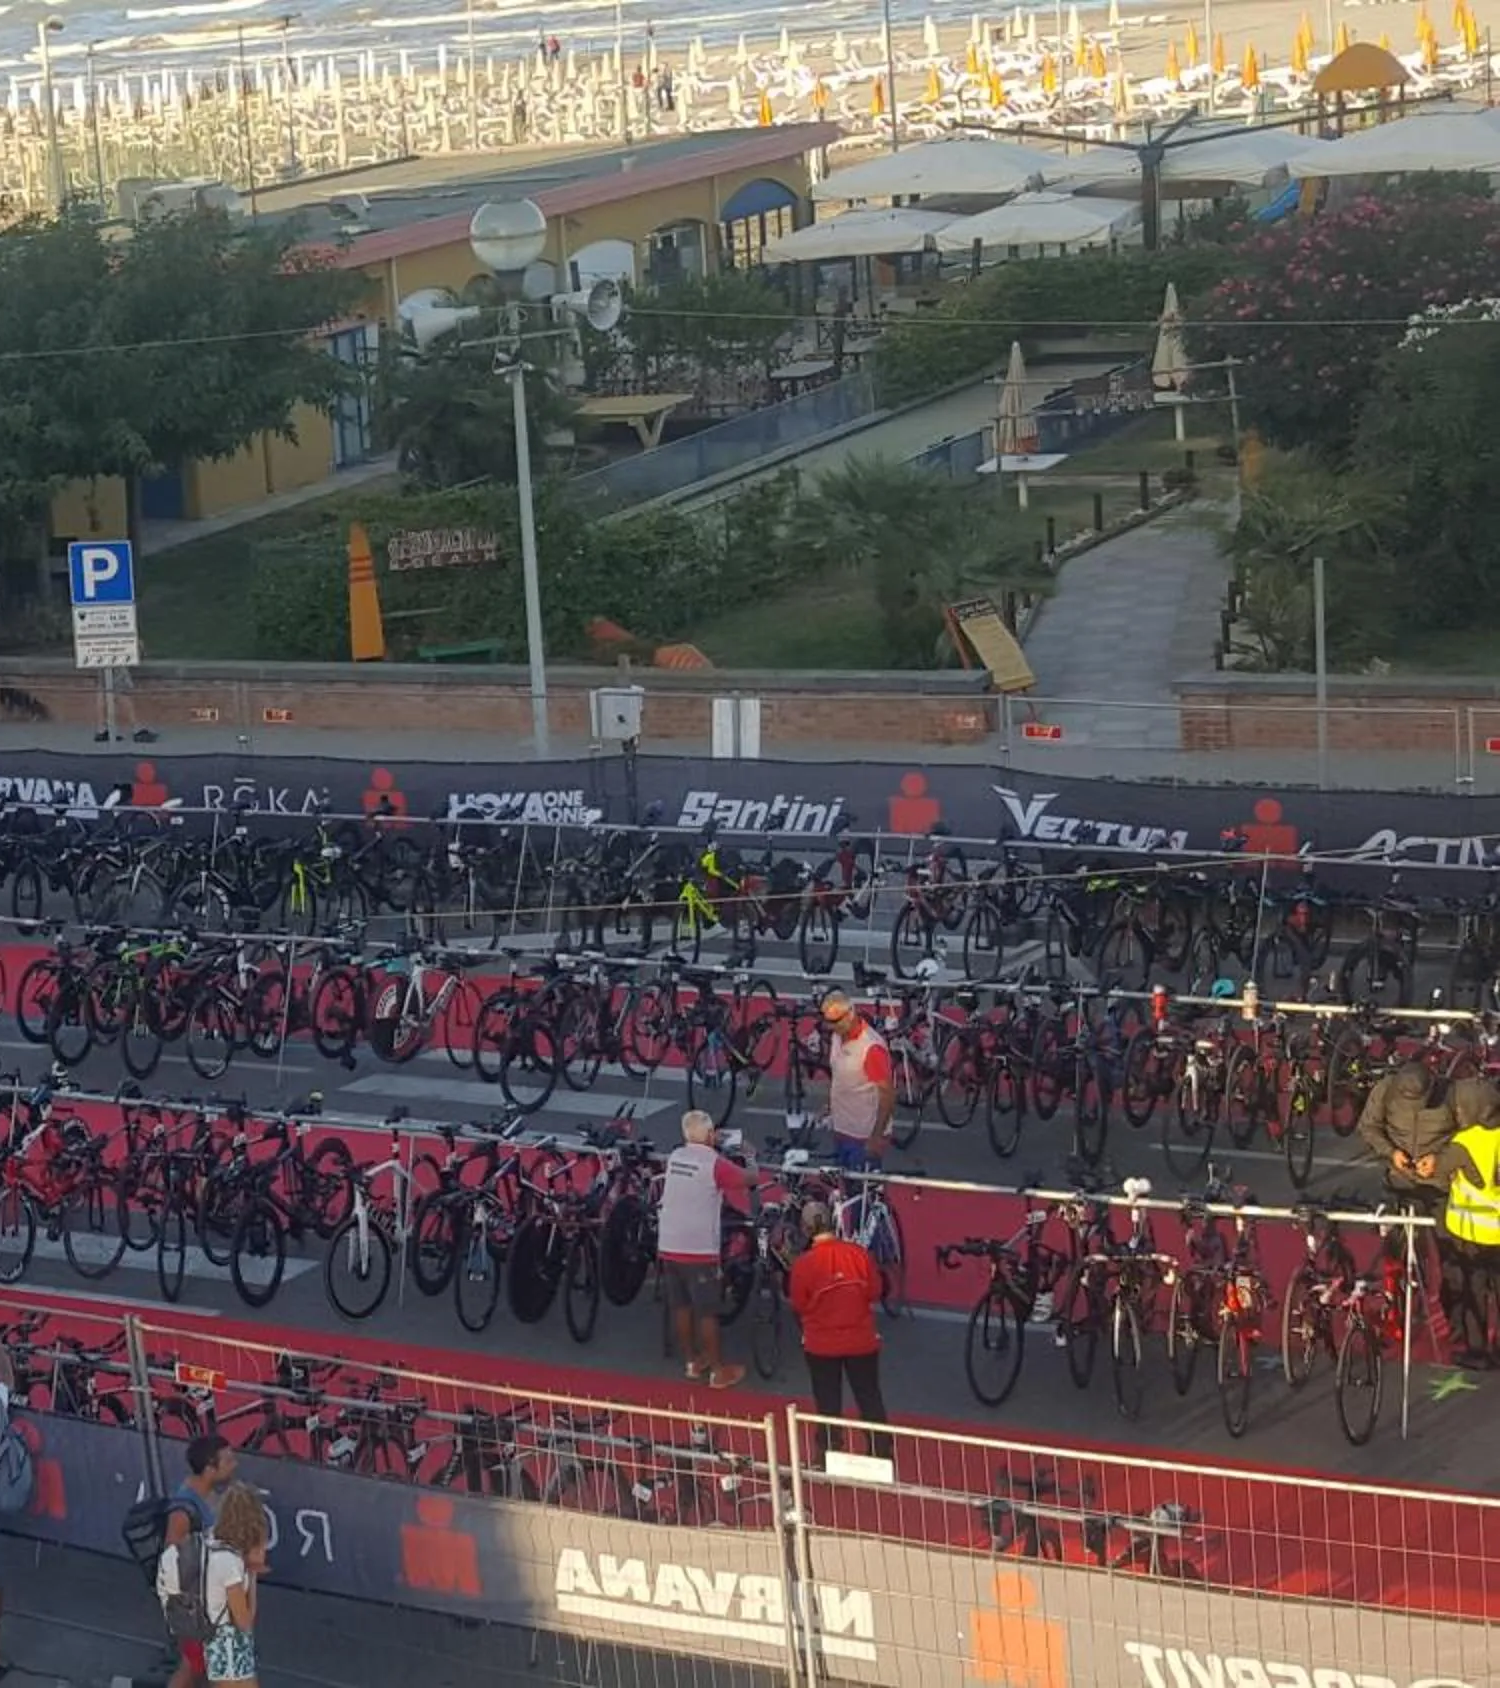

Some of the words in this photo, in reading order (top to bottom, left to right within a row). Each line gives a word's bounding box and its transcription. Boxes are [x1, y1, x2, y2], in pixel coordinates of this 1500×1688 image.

[81, 548, 119, 599] P
[543, 790, 584, 808] ONE
[678, 791, 844, 832] Santini
